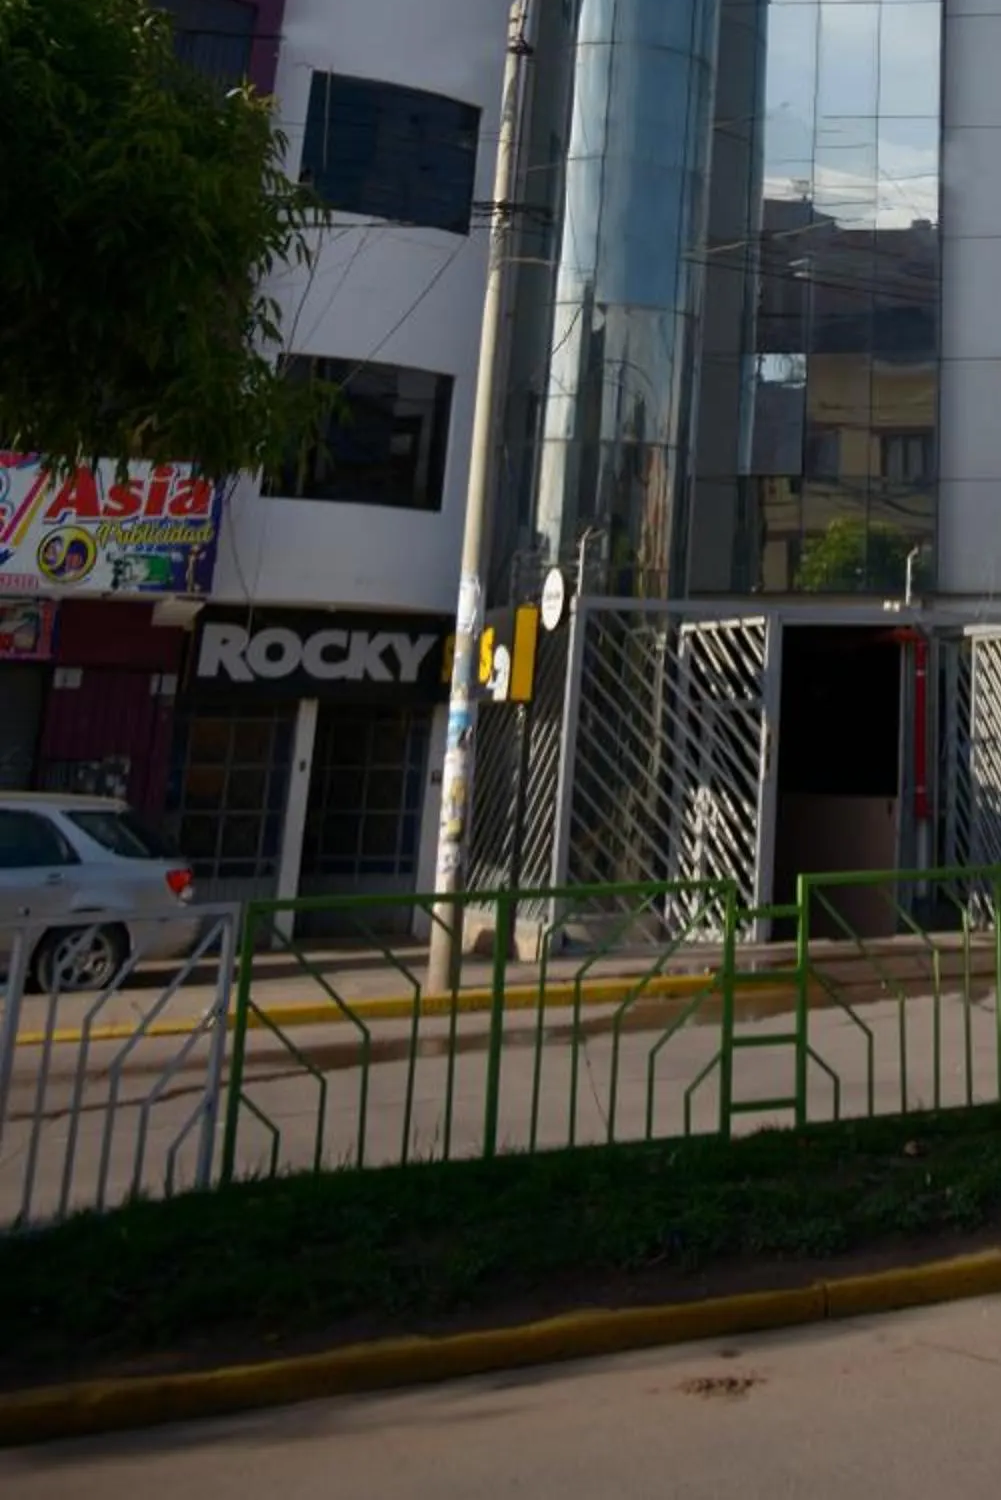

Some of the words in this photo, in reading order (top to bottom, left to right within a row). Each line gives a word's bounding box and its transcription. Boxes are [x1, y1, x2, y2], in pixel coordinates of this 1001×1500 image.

[45, 464, 210, 518] Asia
[97, 518, 213, 549] Publicidad
[197, 621, 439, 683] ROCKY
